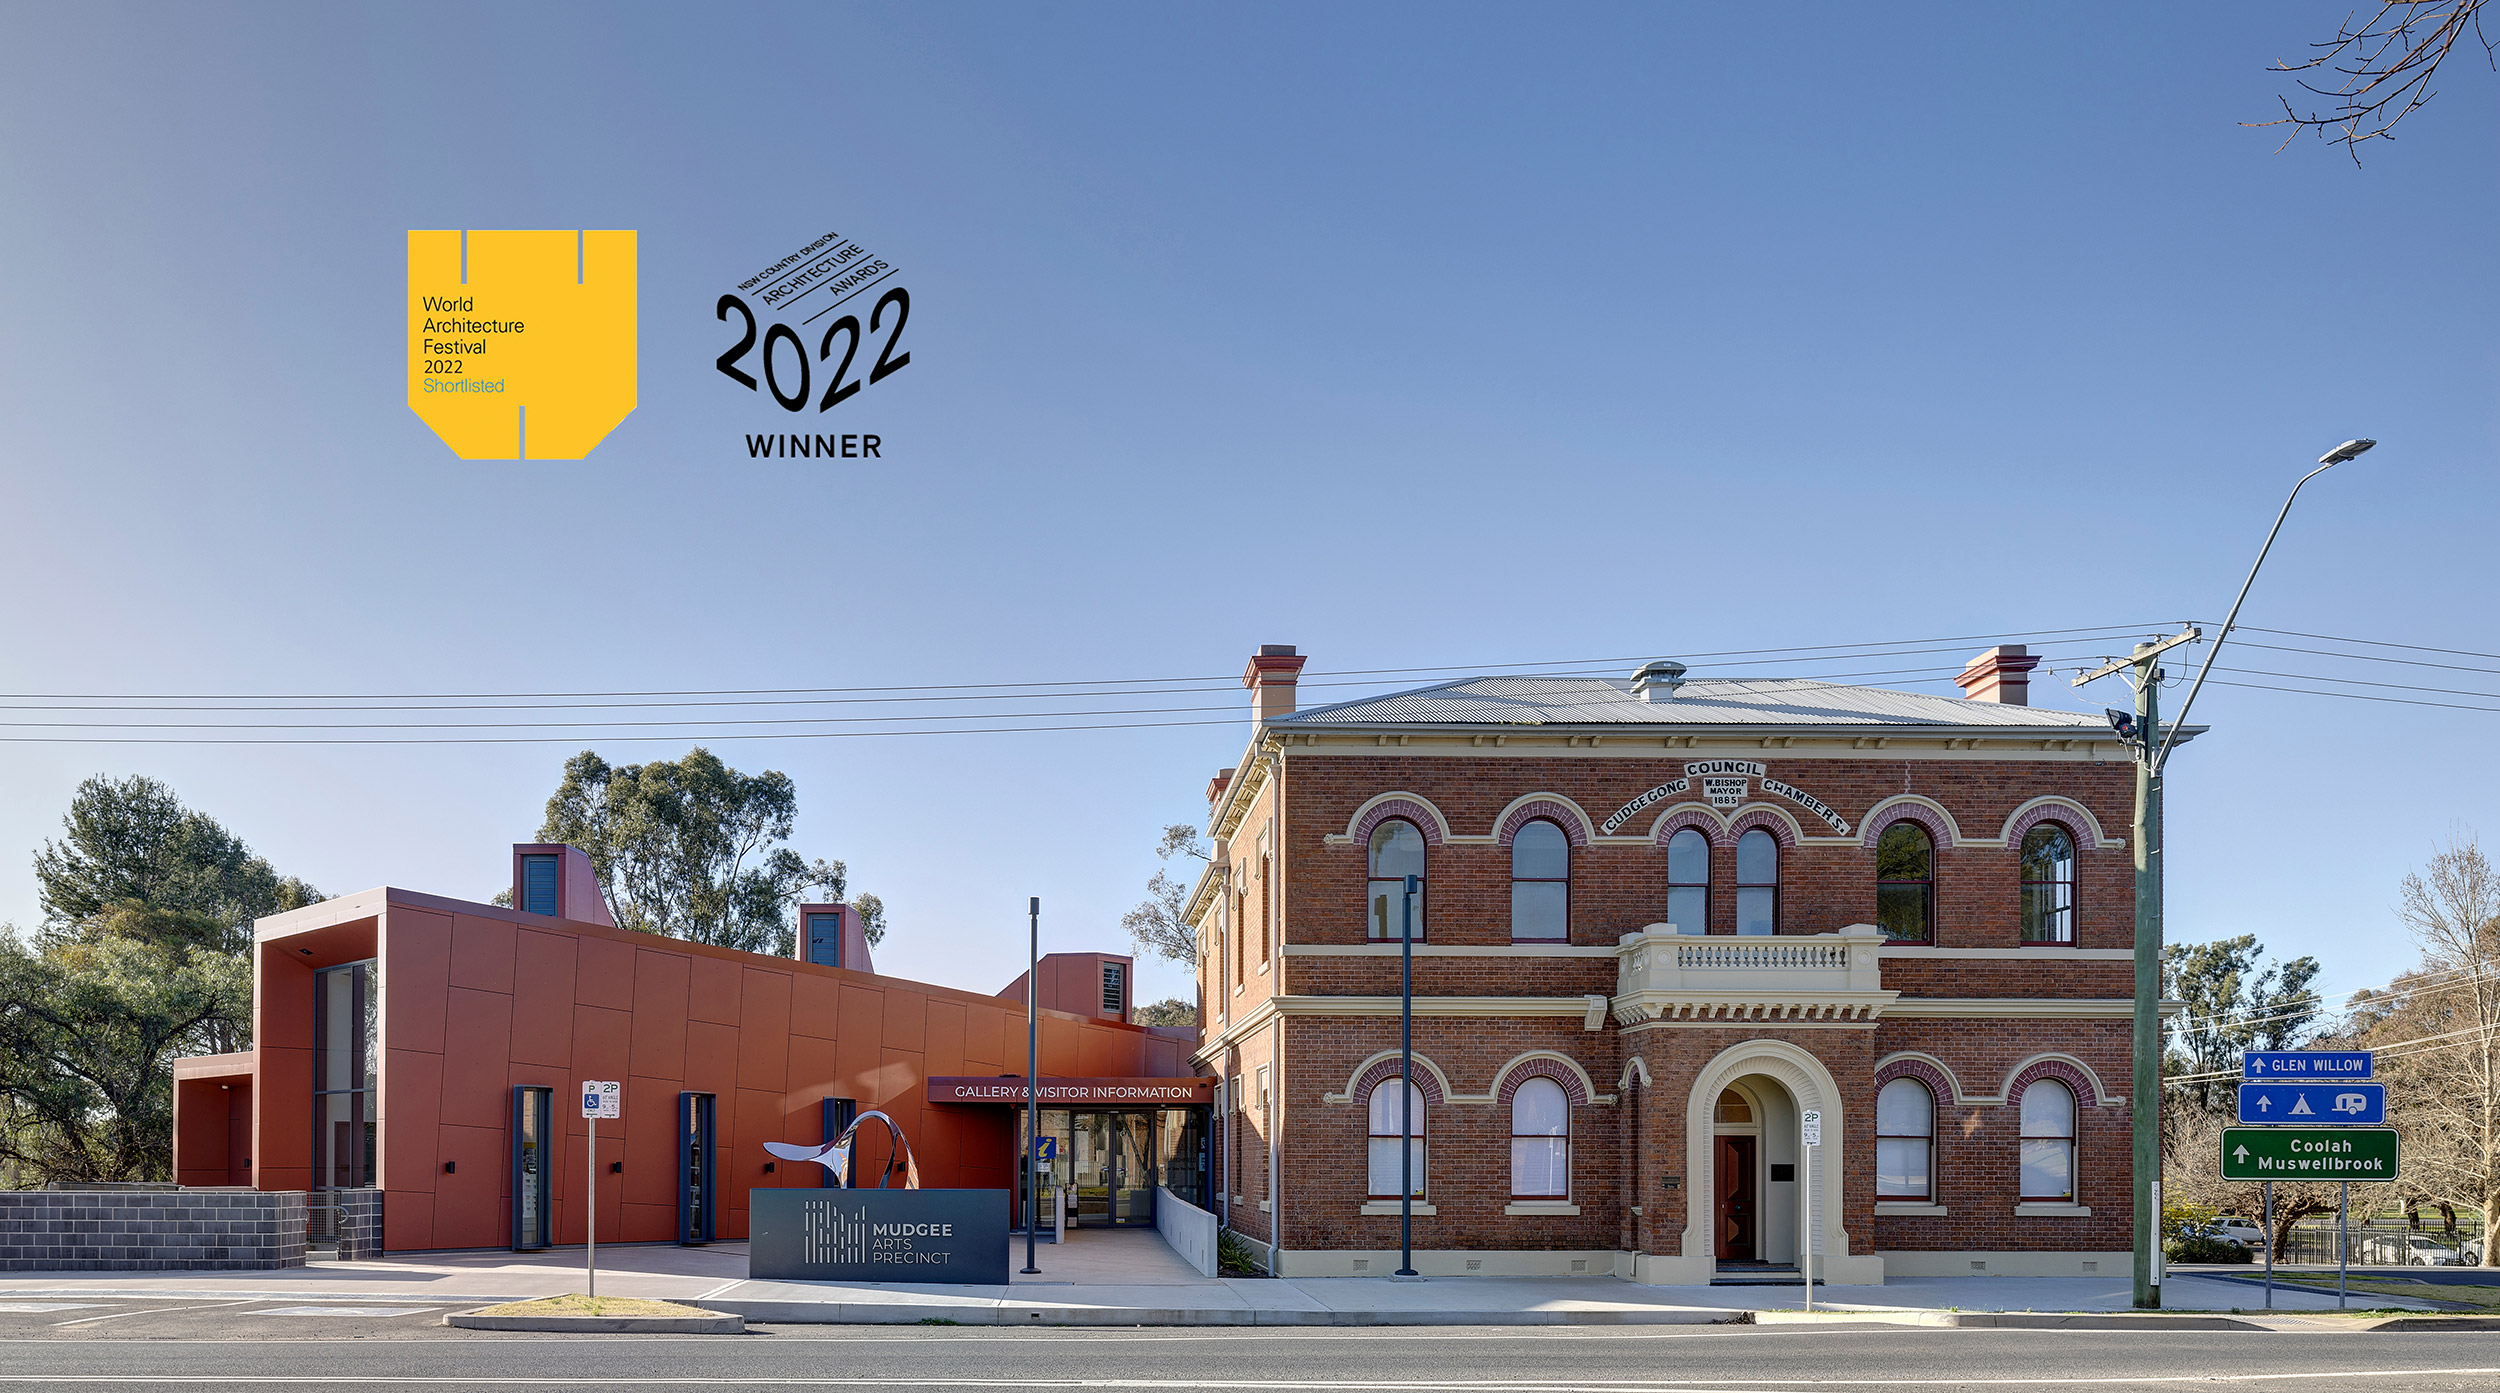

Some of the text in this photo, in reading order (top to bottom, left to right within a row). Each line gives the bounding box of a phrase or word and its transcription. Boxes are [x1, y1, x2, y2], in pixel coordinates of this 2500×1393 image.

[1687, 761, 1762, 776] COUNCIL
[1704, 778, 1747, 787] W.BISHOP
[1709, 787, 1742, 795] MAYOR
[1605, 779, 1687, 831] CUDGEGONG
[1714, 796, 1737, 804] 1885
[2272, 1059, 2364, 1072] GLEN WILLOW
[603, 1084, 618, 1092] 2P
[955, 1086, 1192, 1098] GALLERY & VISITOR INFORMATION
[1804, 1114, 1818, 1122] 2P
[2290, 1139, 2352, 1153] Coolah
[2257, 1157, 2384, 1171] Muswellbrook
[873, 1223, 953, 1236] MUDGEE
[872, 1238, 912, 1250] ARTS
[873, 1252, 951, 1264] PRECINCT
